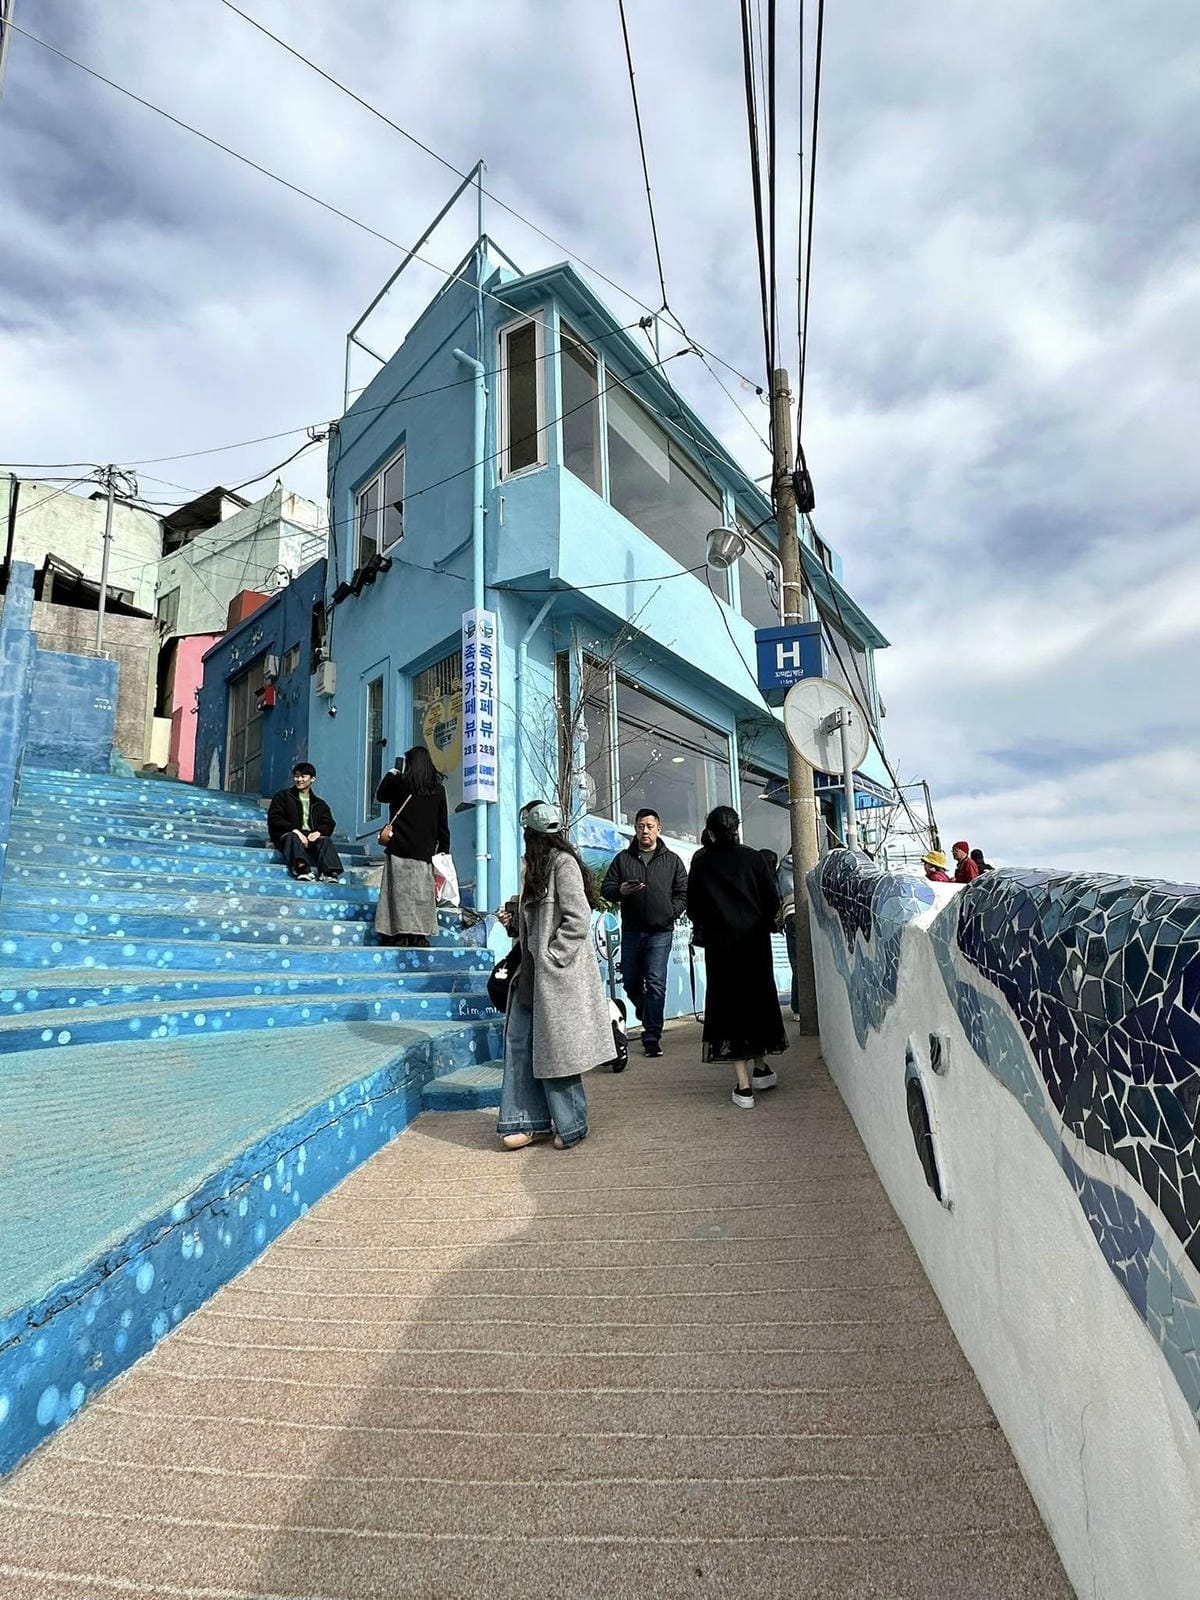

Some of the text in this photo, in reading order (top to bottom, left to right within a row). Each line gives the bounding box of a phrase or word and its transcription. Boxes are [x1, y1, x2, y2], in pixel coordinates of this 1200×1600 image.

[464, 643, 476, 738] 족욕카페 뷰
[479, 643, 493, 738] 족욕카페 뷰
[776, 641, 800, 669] H
